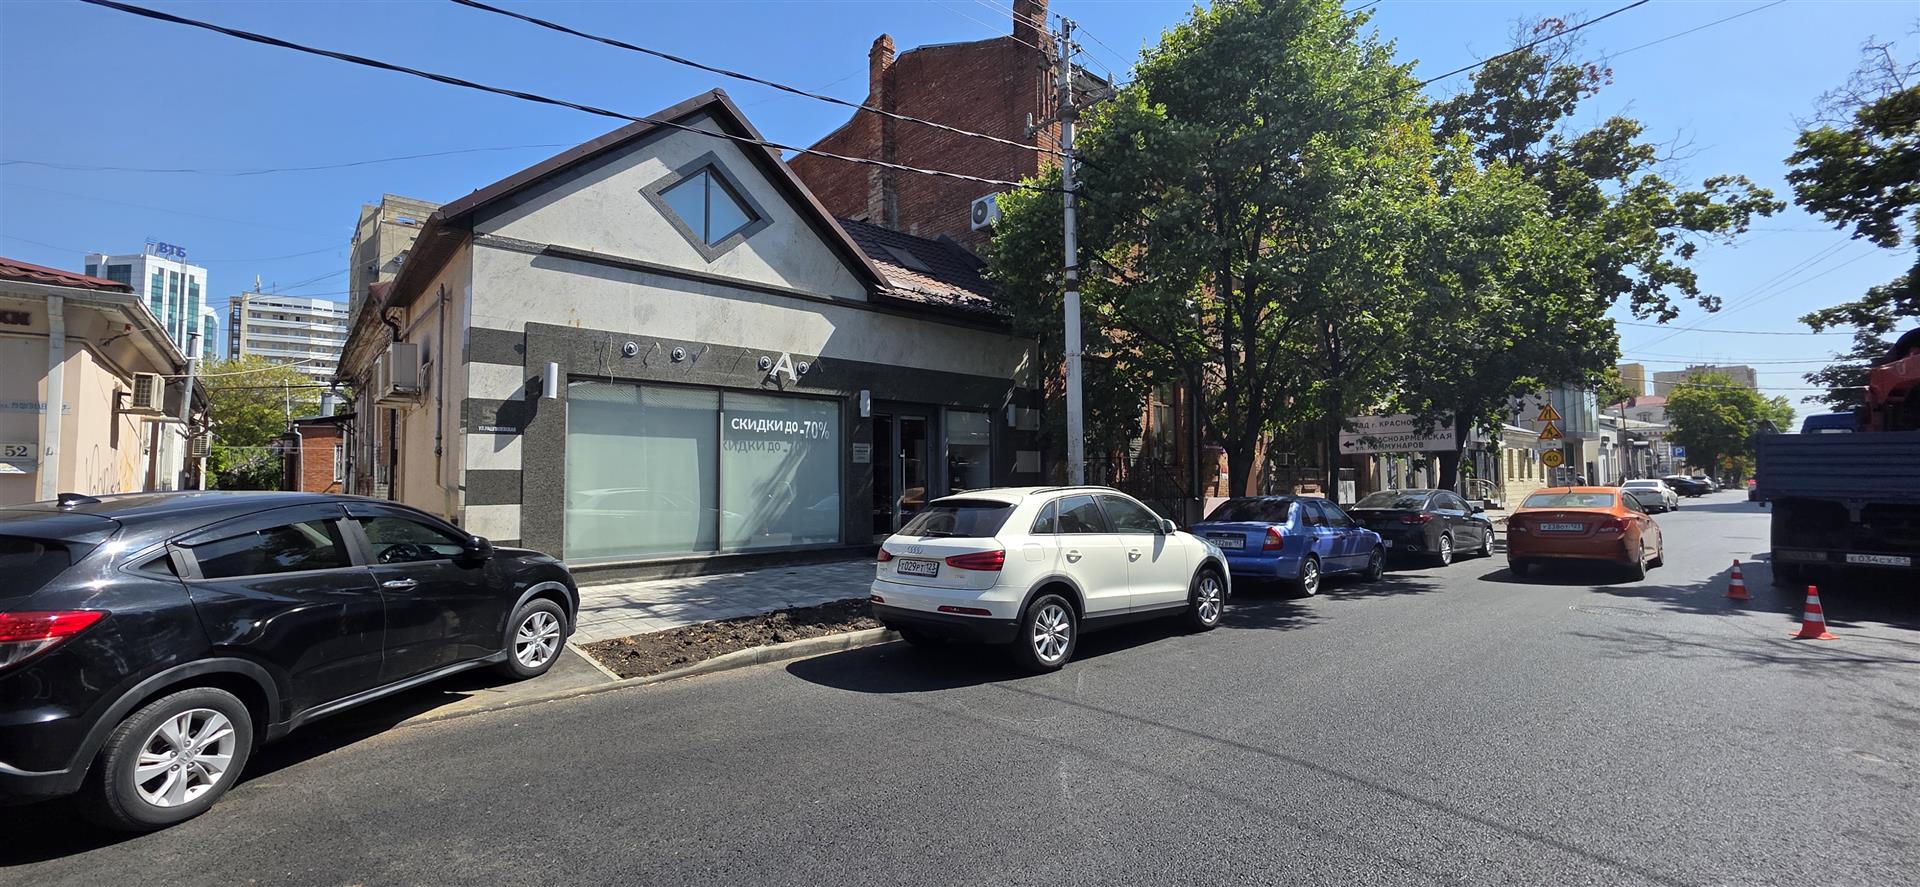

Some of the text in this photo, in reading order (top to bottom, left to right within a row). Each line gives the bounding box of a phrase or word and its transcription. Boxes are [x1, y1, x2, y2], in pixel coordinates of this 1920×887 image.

[159, 241, 186, 257] ВТБ
[769, 352, 797, 381] A
[731, 418, 783, 432] СКИДКИ
[799, 421, 830, 439] -70%
[1379, 419, 1418, 428] КРАСНО
[5, 446, 28, 457] 52
[1675, 447, 1683, 455] P
